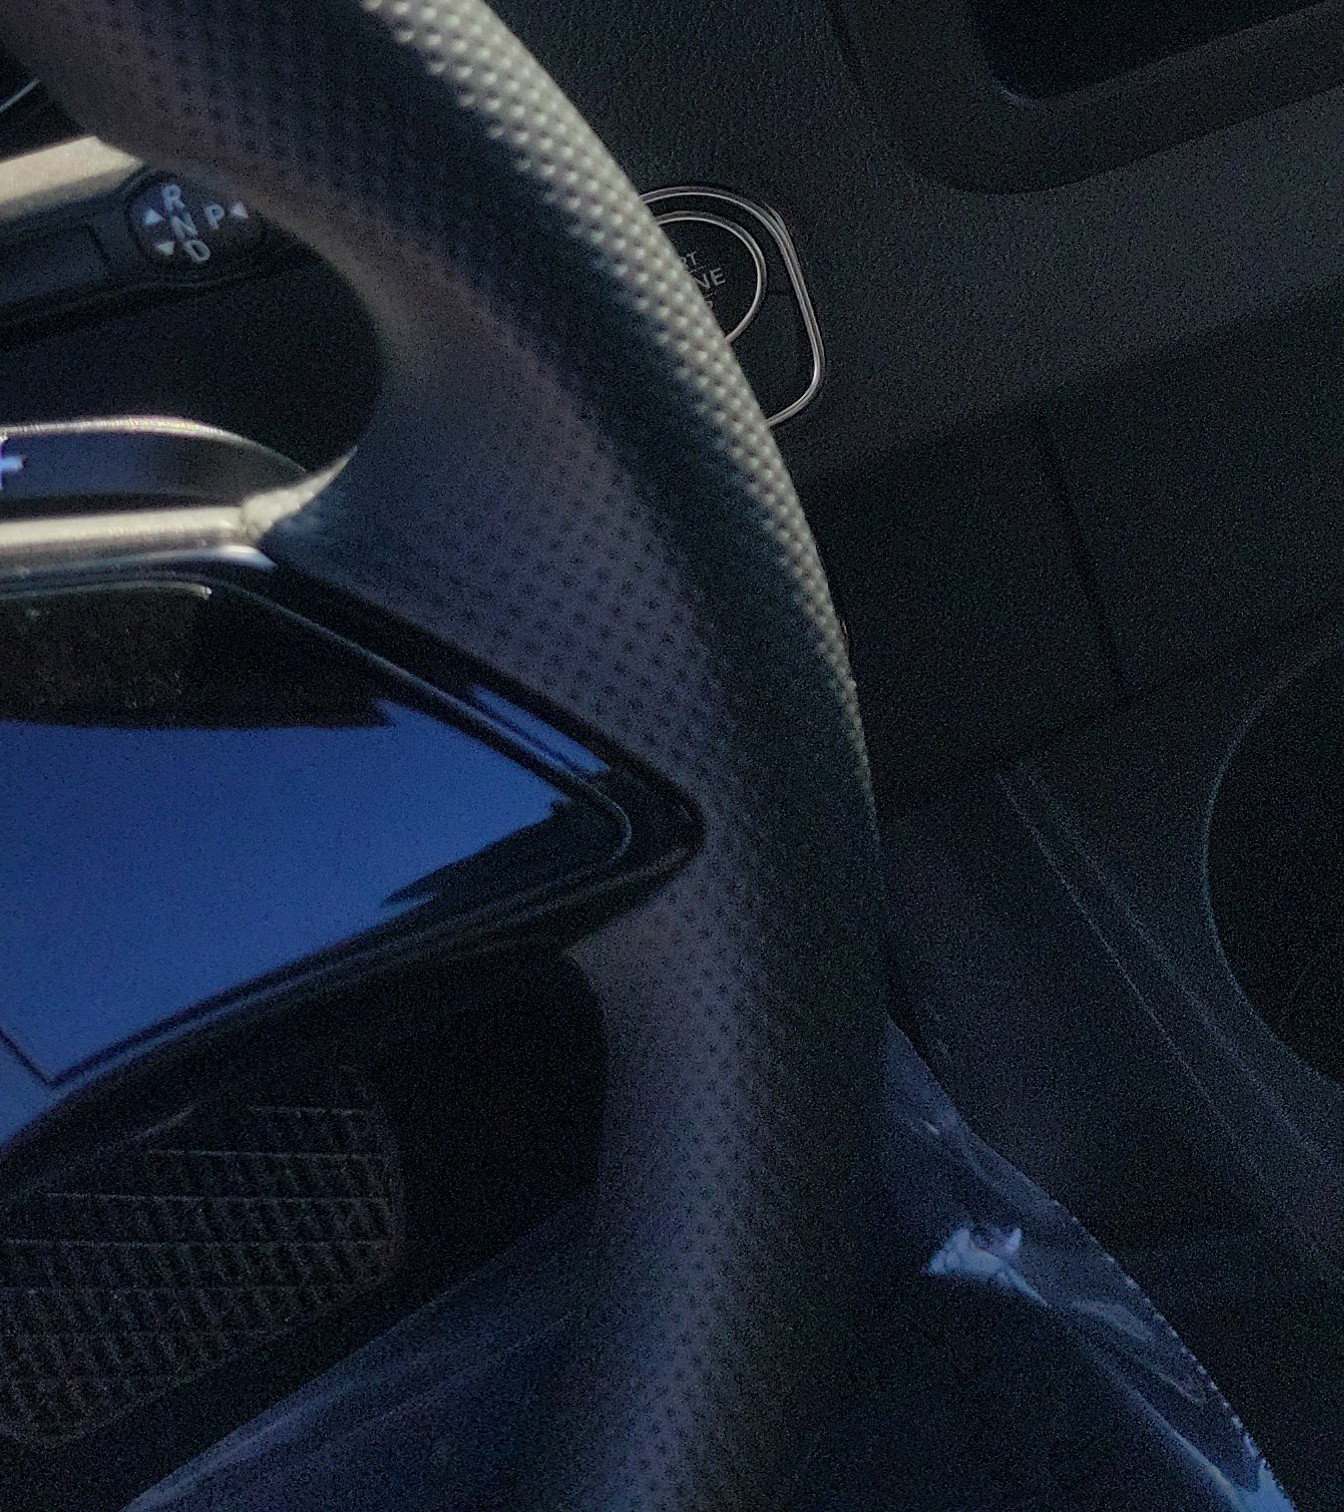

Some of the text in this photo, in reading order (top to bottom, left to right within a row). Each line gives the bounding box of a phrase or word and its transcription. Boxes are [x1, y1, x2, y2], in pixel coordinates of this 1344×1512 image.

[161, 184, 185, 212] R
[169, 211, 199, 240] N
[204, 203, 226, 230] P
[182, 239, 211, 263] D
